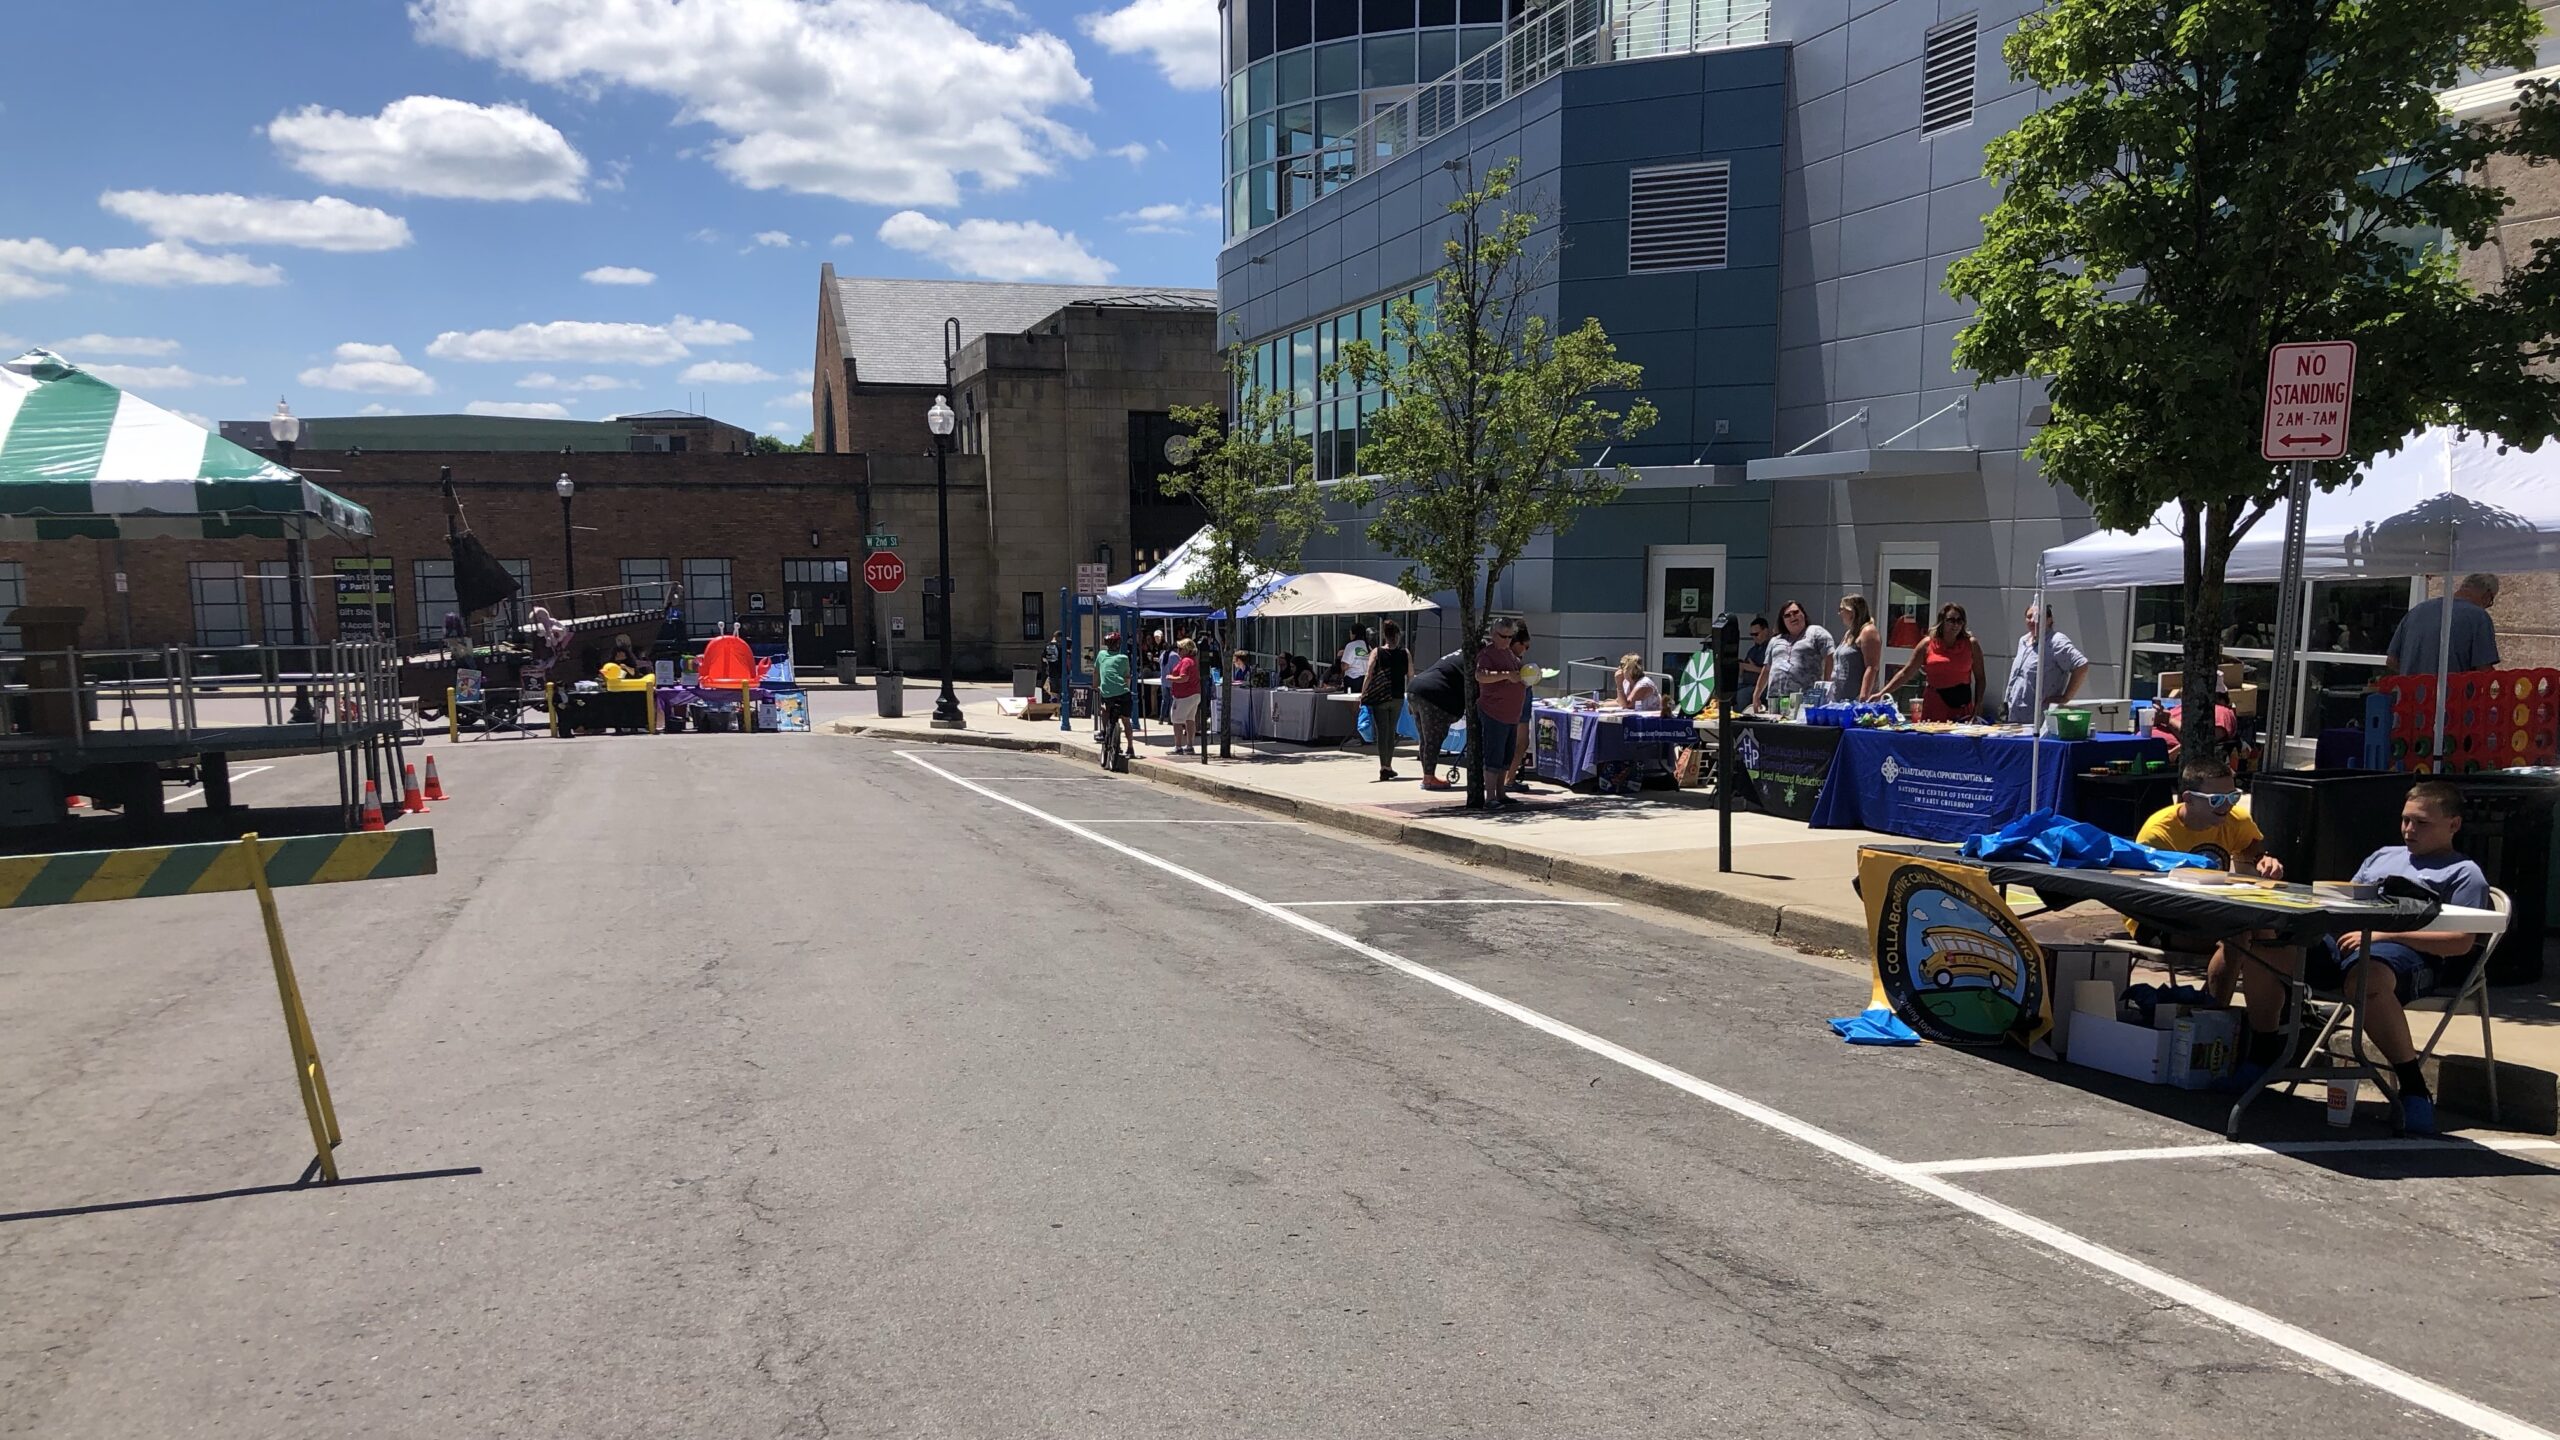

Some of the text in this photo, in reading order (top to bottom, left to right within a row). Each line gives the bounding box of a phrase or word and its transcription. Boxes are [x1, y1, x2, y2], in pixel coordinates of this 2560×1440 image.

[2296, 354, 2326, 376] NO
[2273, 382, 2346, 406] STANDING
[866, 536, 898, 547] W 2nd St
[867, 564, 903, 580] STOP
[350, 583, 379, 591] Parkig
[356, 608, 374, 616] Sho
[1899, 766, 1937, 779] CHAUTAUQUA
[1898, 785, 1925, 795] NATIONAL
[1926, 789, 1948, 797] CENTER
[1957, 792, 1993, 802] EXCELLENCE
[1922, 797, 1939, 806] EARLY
[1940, 799, 1974, 809] CHILDHOOD
[1983, 901, 2038, 984] SOLUTIONS
